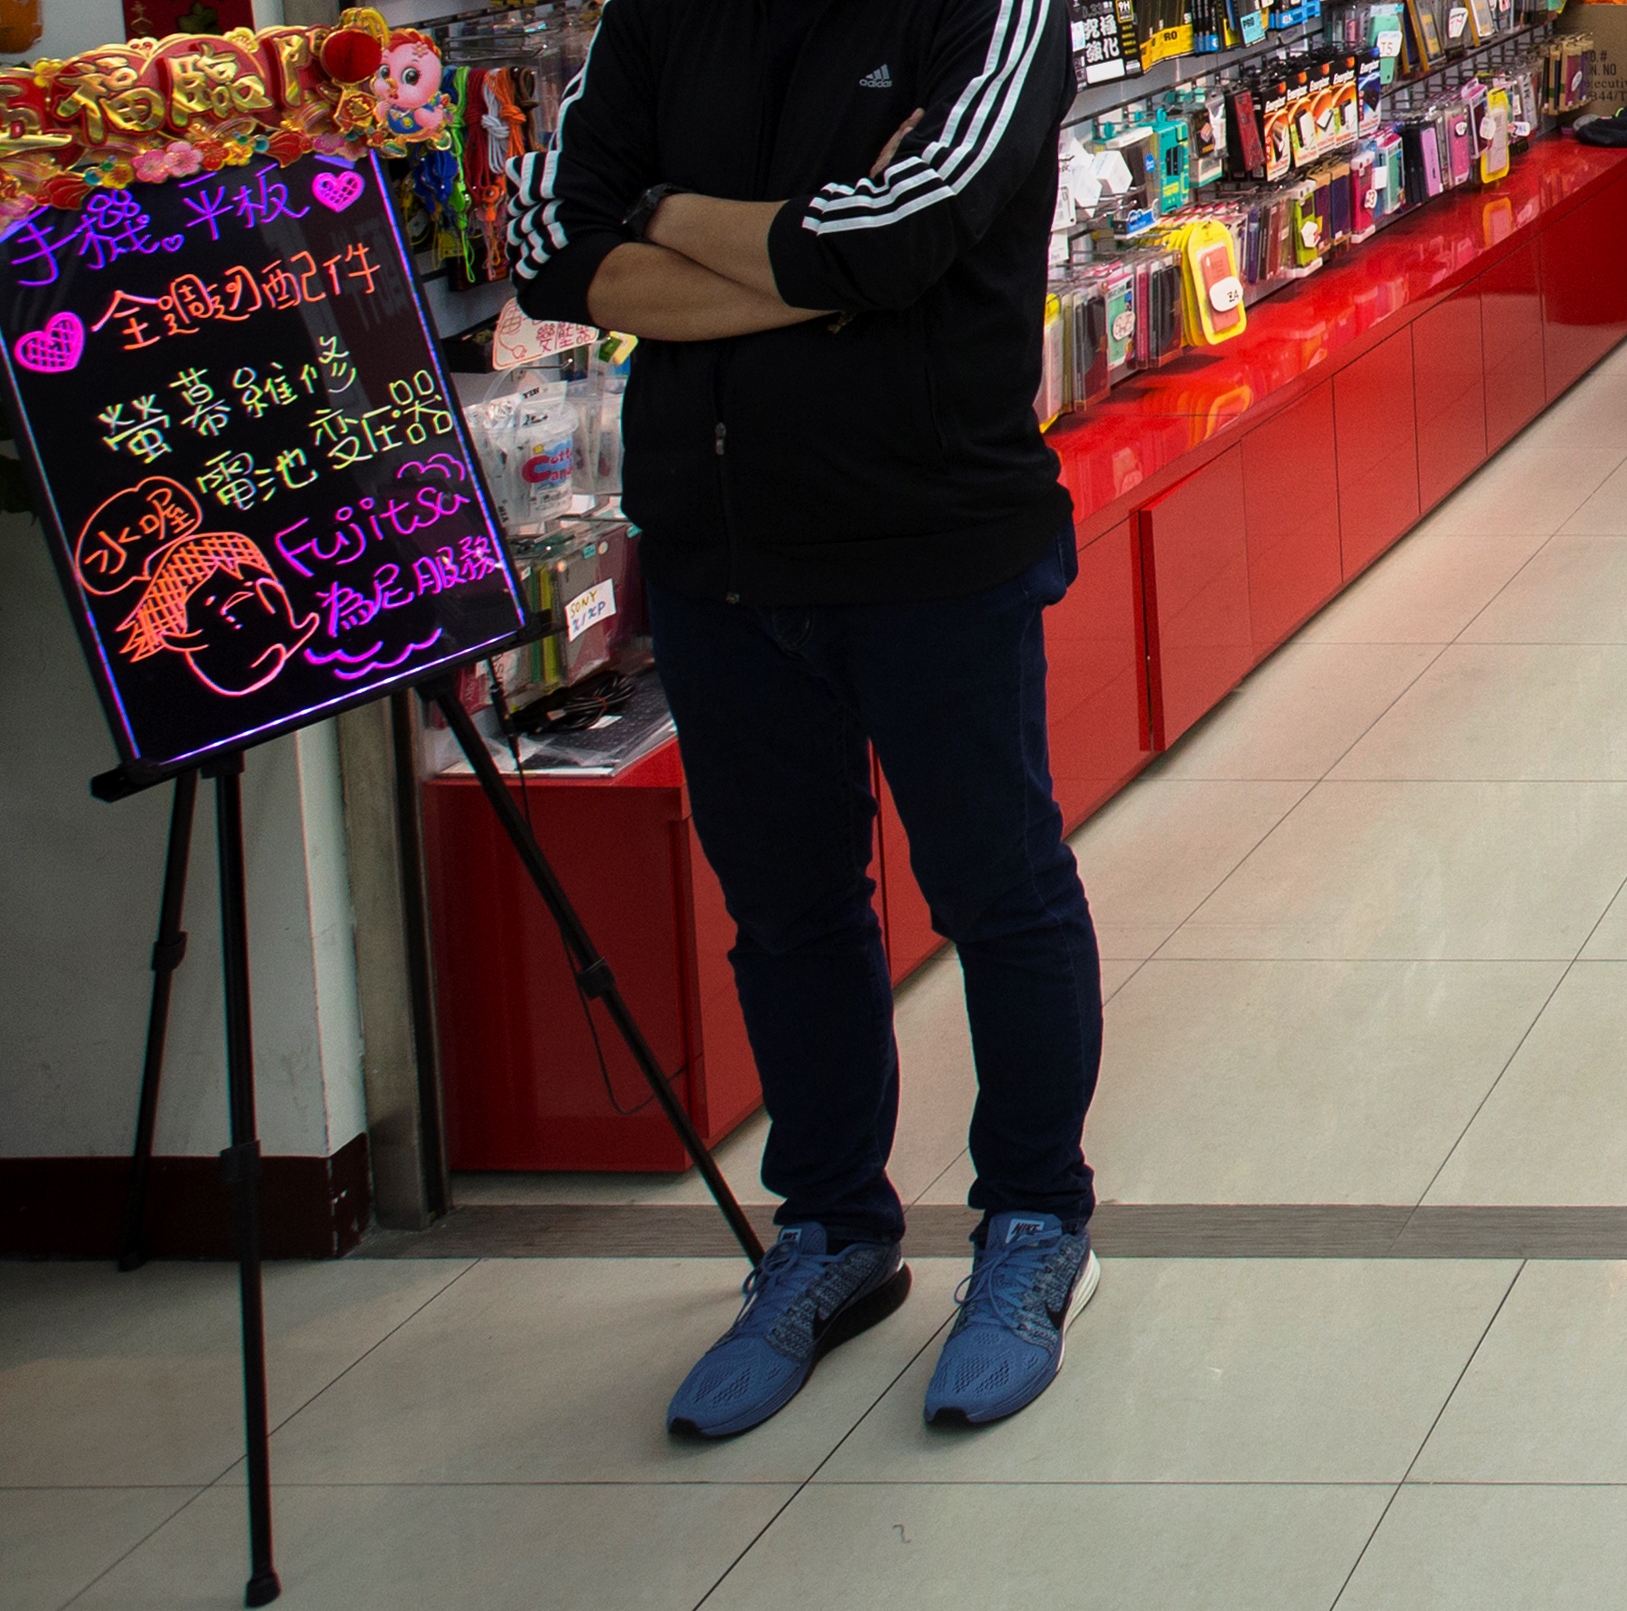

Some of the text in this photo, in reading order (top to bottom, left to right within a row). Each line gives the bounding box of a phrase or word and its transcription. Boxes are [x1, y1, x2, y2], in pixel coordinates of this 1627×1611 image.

[1118, 0, 1131, 12] 9H
[1603, 63, 1617, 76] NO
[97, 336, 359, 464] 螢幕維修
[196, 449, 319, 511] 電池
[275, 486, 470, 577] Fujitsu
